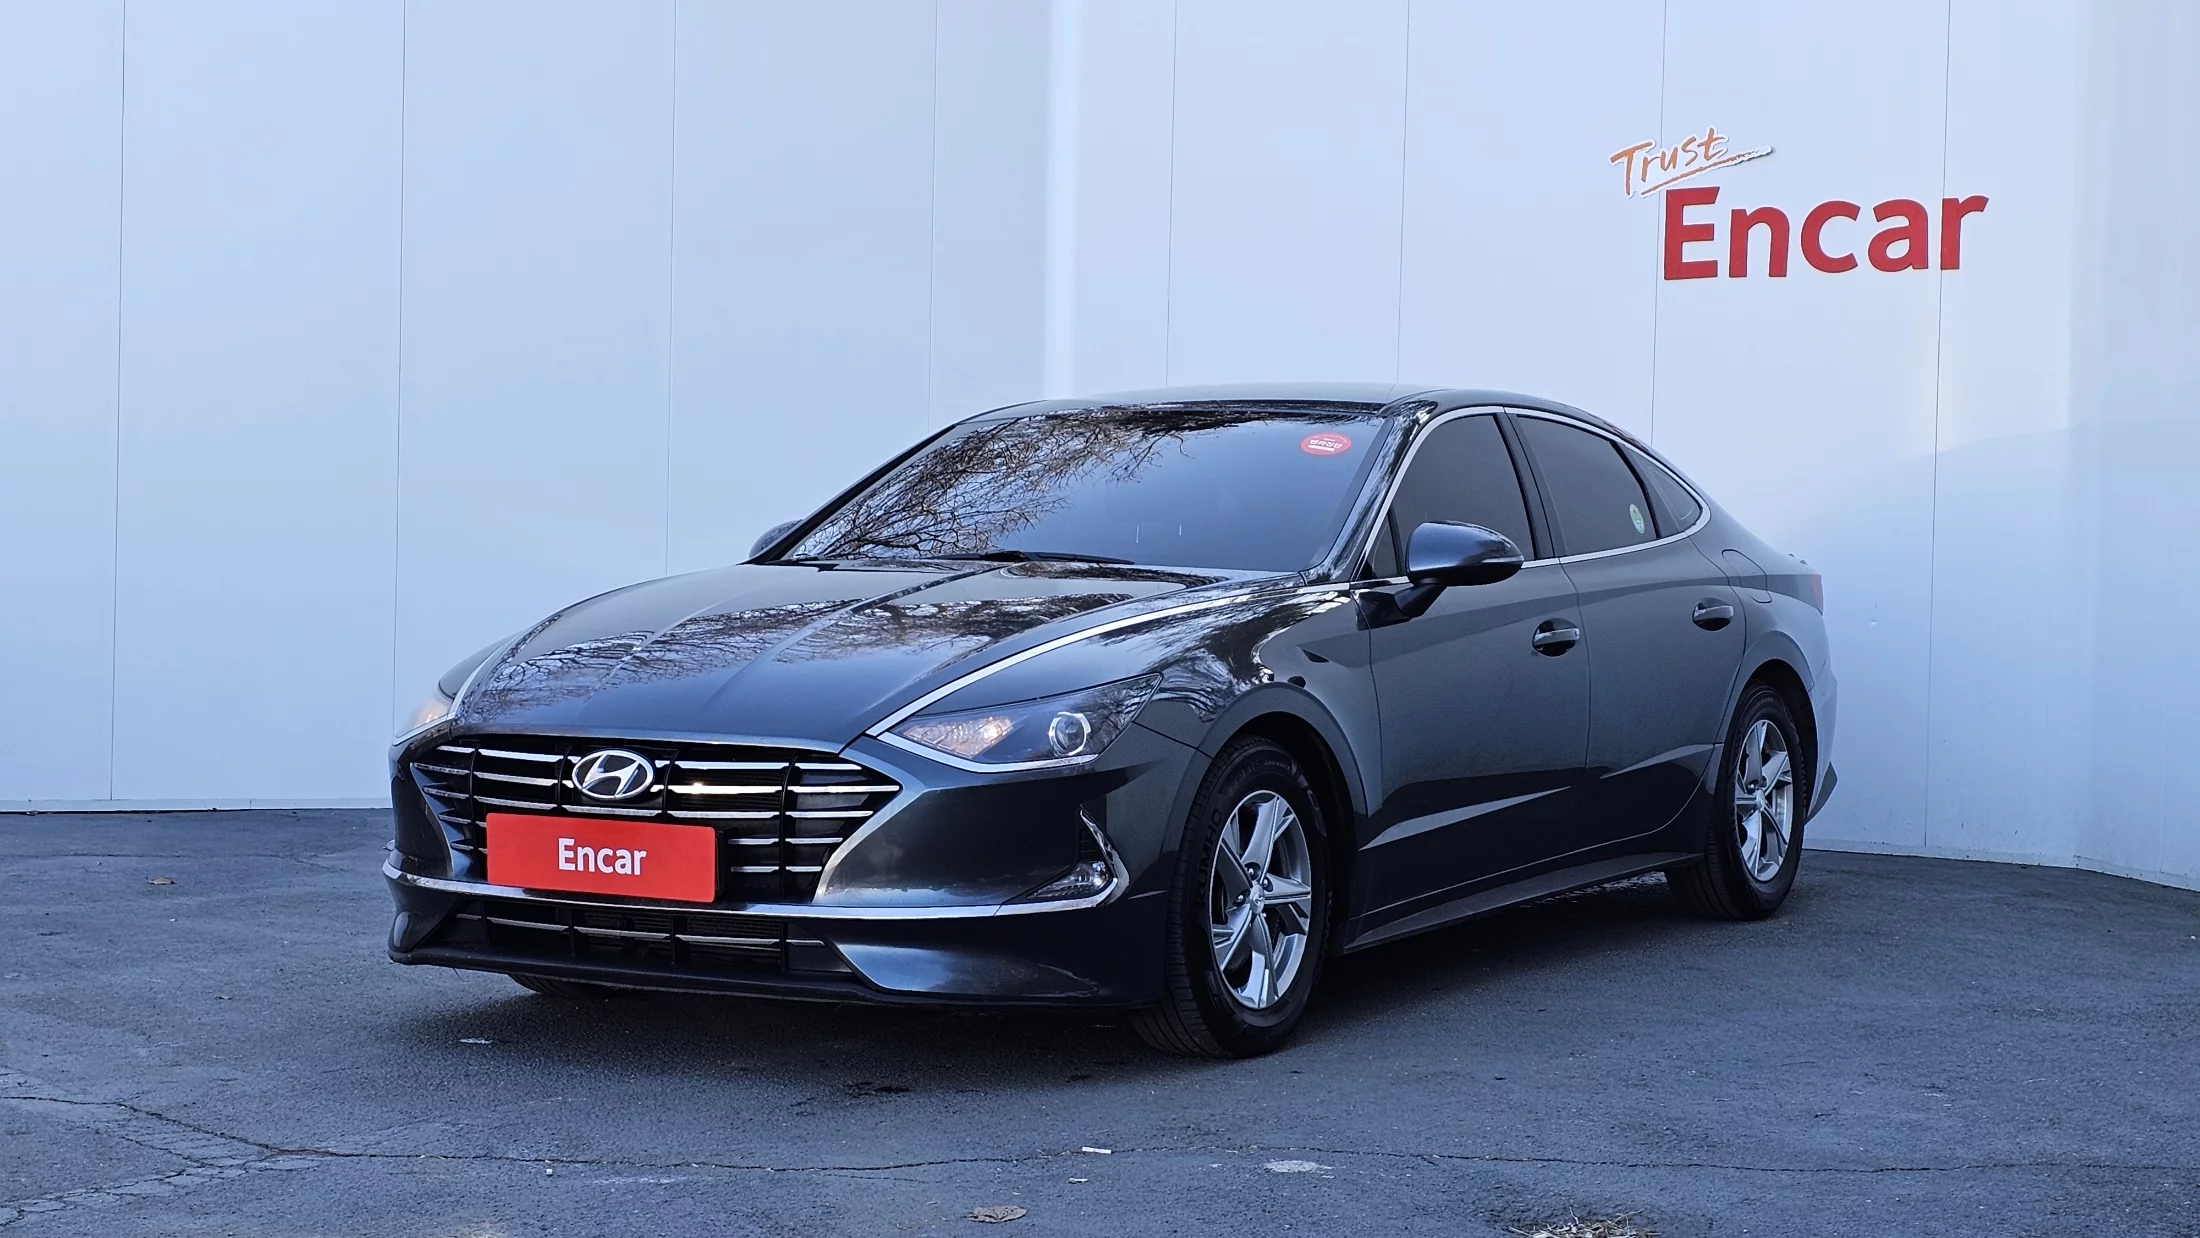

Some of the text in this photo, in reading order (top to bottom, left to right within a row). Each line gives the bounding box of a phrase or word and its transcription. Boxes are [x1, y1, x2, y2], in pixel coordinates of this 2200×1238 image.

[1610, 126, 1728, 196] Trust
[1664, 186, 1989, 280] Encar
[557, 837, 647, 876] Encar
[1196, 806, 1223, 906] KUMHO
